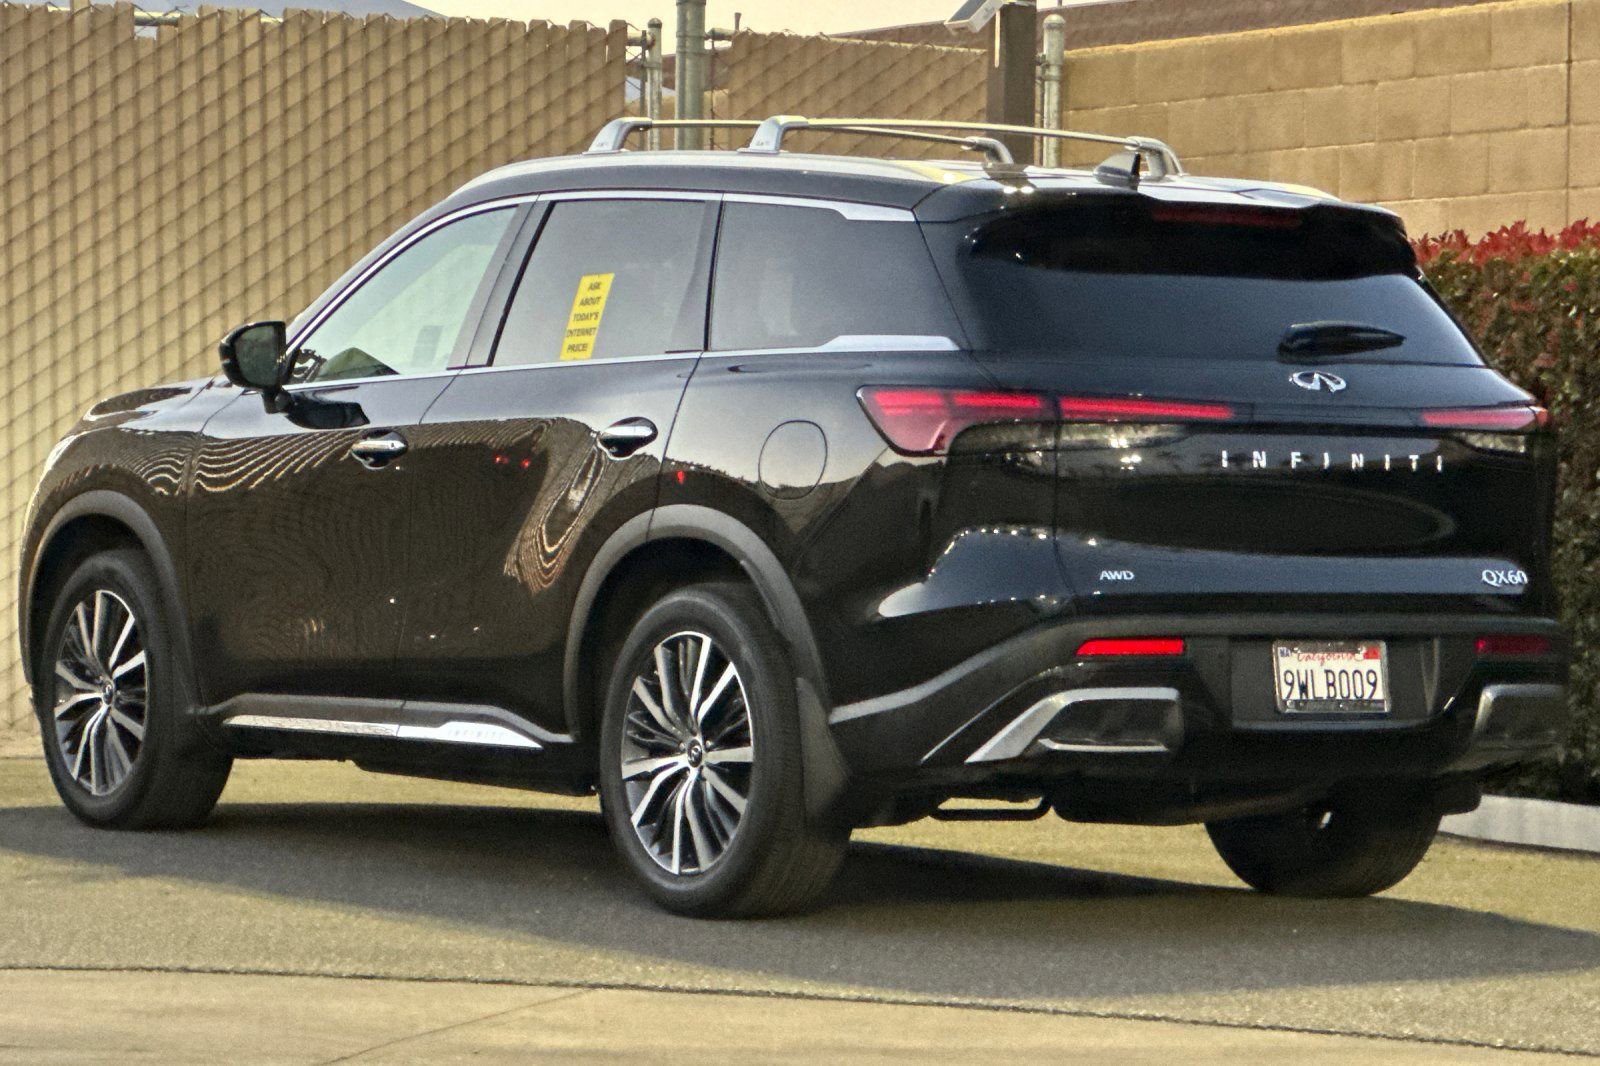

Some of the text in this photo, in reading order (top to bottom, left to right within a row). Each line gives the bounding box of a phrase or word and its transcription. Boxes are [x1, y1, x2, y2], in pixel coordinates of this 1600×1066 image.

[579, 296, 602, 306] ABOUT
[573, 312, 600, 321] TODAY'S
[566, 327, 597, 337] INTERNET
[1221, 450, 1443, 472] INFINITI
[1099, 570, 1135, 580] AWD
[1481, 569, 1528, 587] QX60
[1283, 668, 1378, 700] 9WLB009
